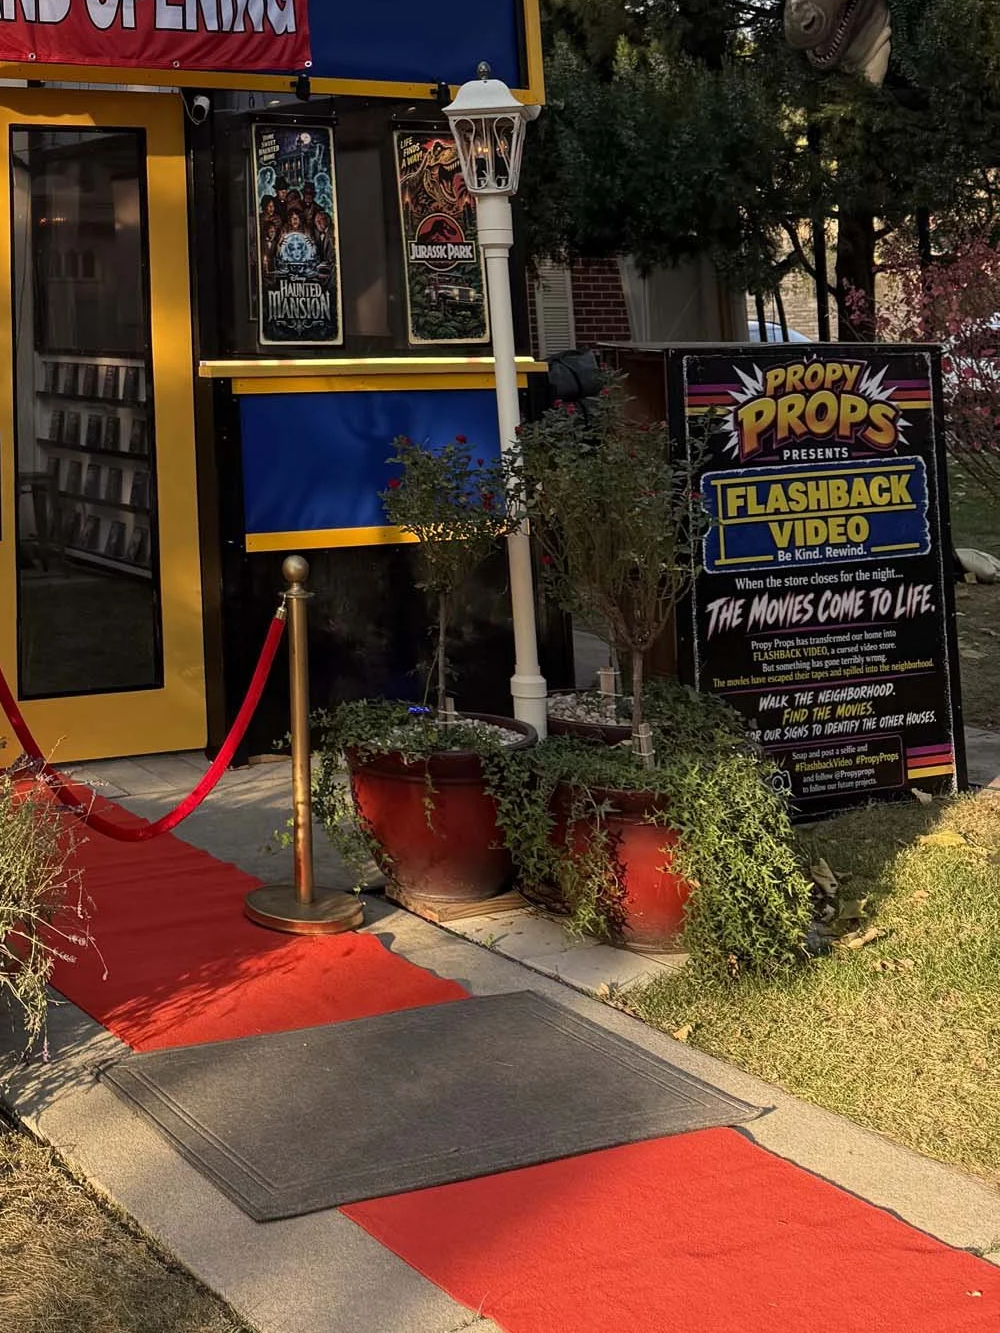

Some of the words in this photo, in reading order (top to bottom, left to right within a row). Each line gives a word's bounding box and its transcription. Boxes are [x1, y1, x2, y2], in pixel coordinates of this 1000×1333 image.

[400, 136, 413, 149] LIFE
[403, 143, 420, 157] FINDS
[401, 159, 406, 169] A
[407, 150, 422, 165] WAY!
[411, 243, 447, 260] JURASSIC
[447, 243, 473, 260] PARK
[280, 280, 322, 297] HAUNTED
[268, 289, 330, 322] MANSION
[766, 362, 861, 397] PROPY
[738, 390, 899, 459] PROPS
[783, 447, 849, 460] PRESENTS
[727, 474, 913, 516] FLASHBACK
[769, 516, 869, 548] VIDEO
[778, 549, 792, 562] Be
[795, 546, 823, 560] Kind.
[826, 544, 867, 558] Rewind.
[736, 577, 763, 590] When
[766, 576, 782, 588] the
[784, 575, 808, 587] store
[810, 572, 838, 585] closes
[840, 571, 853, 583] for
[855, 570, 870, 582] the
[872, 568, 904, 583] night...
[705, 596, 746, 642] THE
[747, 589, 814, 632] MOVIES
[817, 586, 866, 623] COME
[870, 586, 892, 621] TO
[894, 581, 936, 619] LIFE.
[751, 640, 772, 651] Propy
[774, 638, 795, 649] Props
[796, 636, 808, 646] has
[809, 632, 850, 645] transformed
[851, 632, 863, 641] our
[864, 630, 882, 640] home
[883, 629, 896, 638] into
[753, 648, 802, 661] FLASHBACK
[802, 646, 829, 658] VIDEO,
[831, 647, 835, 655] a
[836, 644, 858, 655] cursed
[860, 642, 877, 653] video
[879, 642, 896, 651] store.
[713, 678, 725, 688] The
[727, 676, 750, 686] movies
[751, 674, 766, 684] have
[768, 672, 793, 684] escaped
[795, 670, 811, 681] their
[812, 670, 829, 681] tapes
[830, 668, 841, 677] and
[842, 666, 865, 678] spilled
[865, 665, 878, 674] into
[879, 663, 890, 672] the
[891, 659, 934, 673] neighborhood.
[762, 663, 774, 673] But
[775, 660, 810, 673] something
[811, 659, 823, 669] has
[824, 659, 840, 669] gone
[841, 655, 865, 667] terribly
[758, 693, 789, 712] WALK
[794, 692, 814, 706] THE
[818, 683, 896, 703] NEIGHBORHOOD.
[782, 708, 808, 725] FIND
[812, 706, 832, 720] THE
[835, 701, 875, 718] MOVIES.
[746, 730, 762, 743] OR
[764, 728, 782, 741] OUR
[783, 725, 809, 740] SIGNS
[812, 724, 822, 737] TO
[824, 719, 860, 734] IDENTIFY
[862, 718, 878, 731] THE
[880, 715, 904, 728] OTHER
[906, 711, 937, 726] HOUSES.
[792, 751, 807, 761] Snap
[808, 750, 820, 759] and
[821, 749, 834, 759] post
[841, 746, 856, 755] selfie
[856, 744, 868, 753] and
[795, 758, 853, 773] #FlashbackVideo
[856, 752, 899, 766] #PropyProps
[803, 774, 814, 783] and
[815, 771, 833, 782] follow
[834, 768, 875, 780] @Propyprops
[803, 785, 809, 793] to
[810, 783, 826, 792] follow
[827, 782, 838, 790] our
